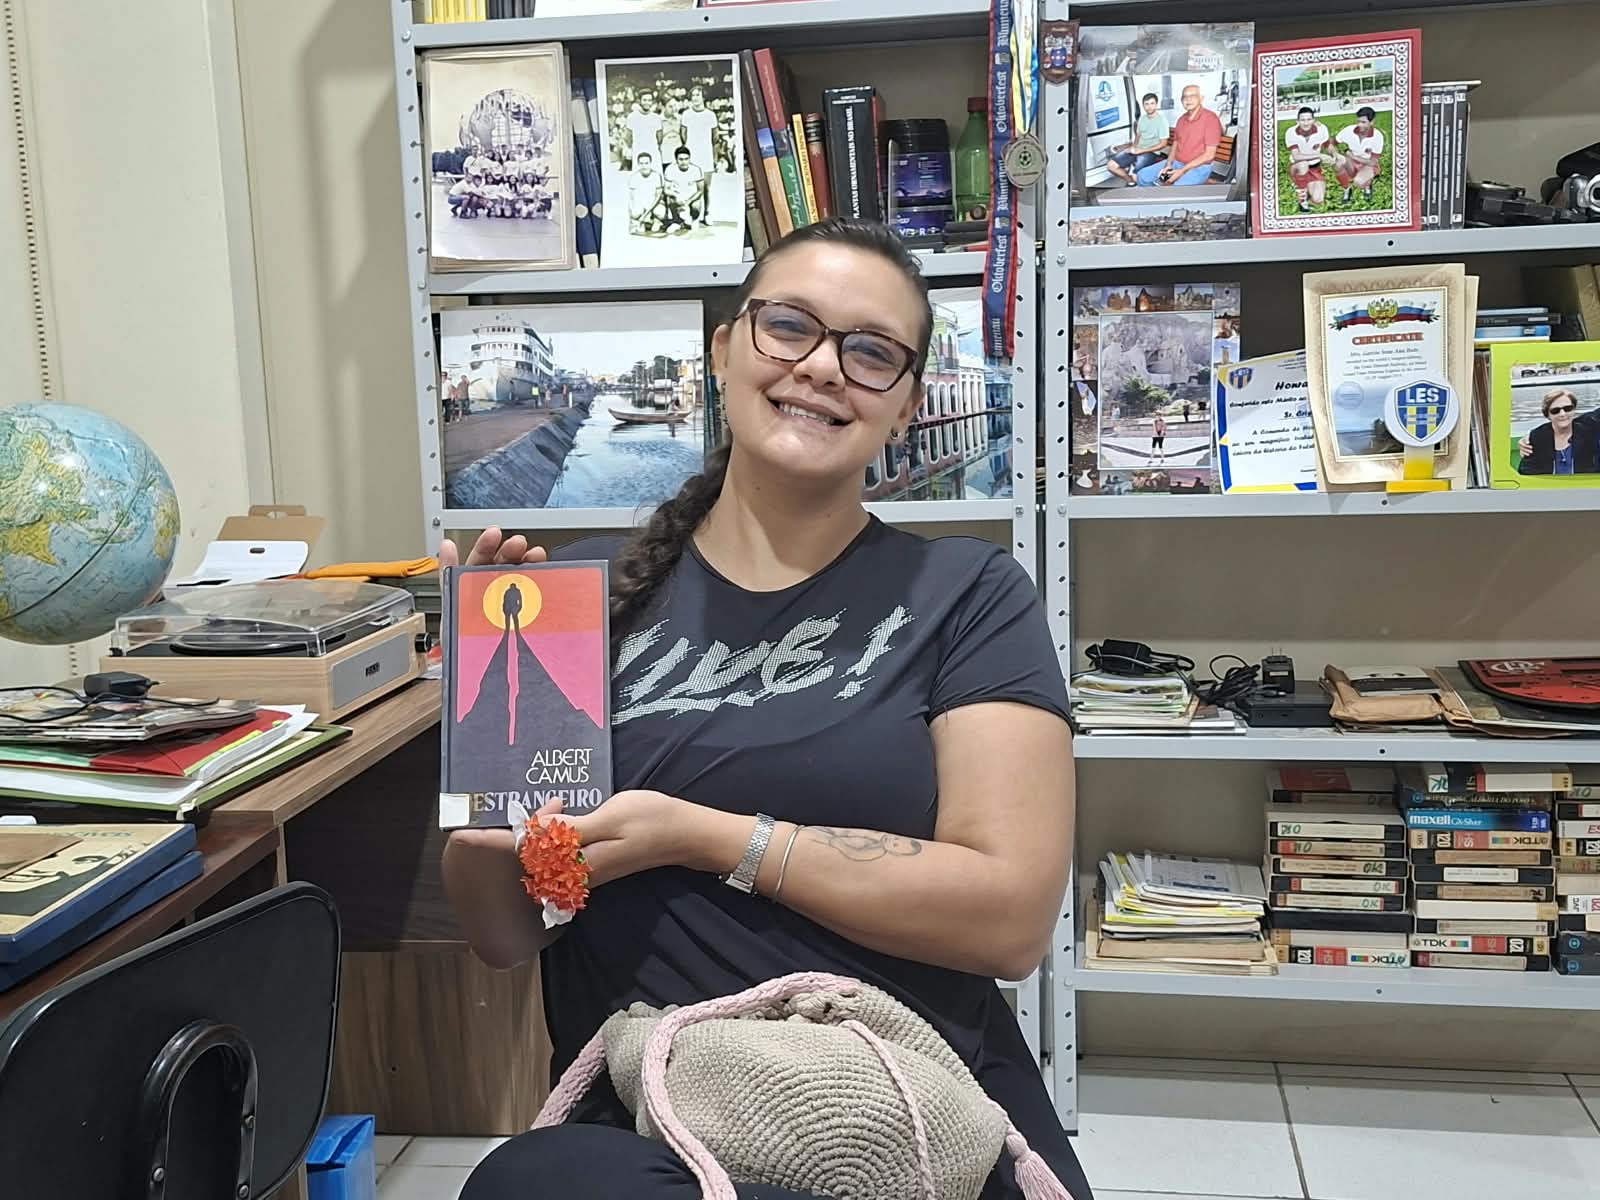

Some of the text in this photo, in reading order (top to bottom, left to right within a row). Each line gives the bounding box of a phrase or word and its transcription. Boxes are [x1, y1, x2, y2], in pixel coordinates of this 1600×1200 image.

[995, 0, 1009, 133] Oktoberfest Blumena
[844, 105, 855, 131] BRASIL
[847, 130, 855, 142] NO
[848, 142, 859, 190] ORNAMENTAIS
[992, 234, 1008, 293] Oktoberfest
[1405, 387, 1440, 404] LES
[530, 748, 594, 767] ALBERT
[525, 766, 590, 785] CAMUS
[1409, 814, 1451, 825] maxell
[1436, 832, 1451, 848] 120
[1513, 836, 1540, 845] TDK
[1421, 937, 1447, 948] TDK
[1509, 938, 1525, 953] 120
[1297, 950, 1313, 965] 120
